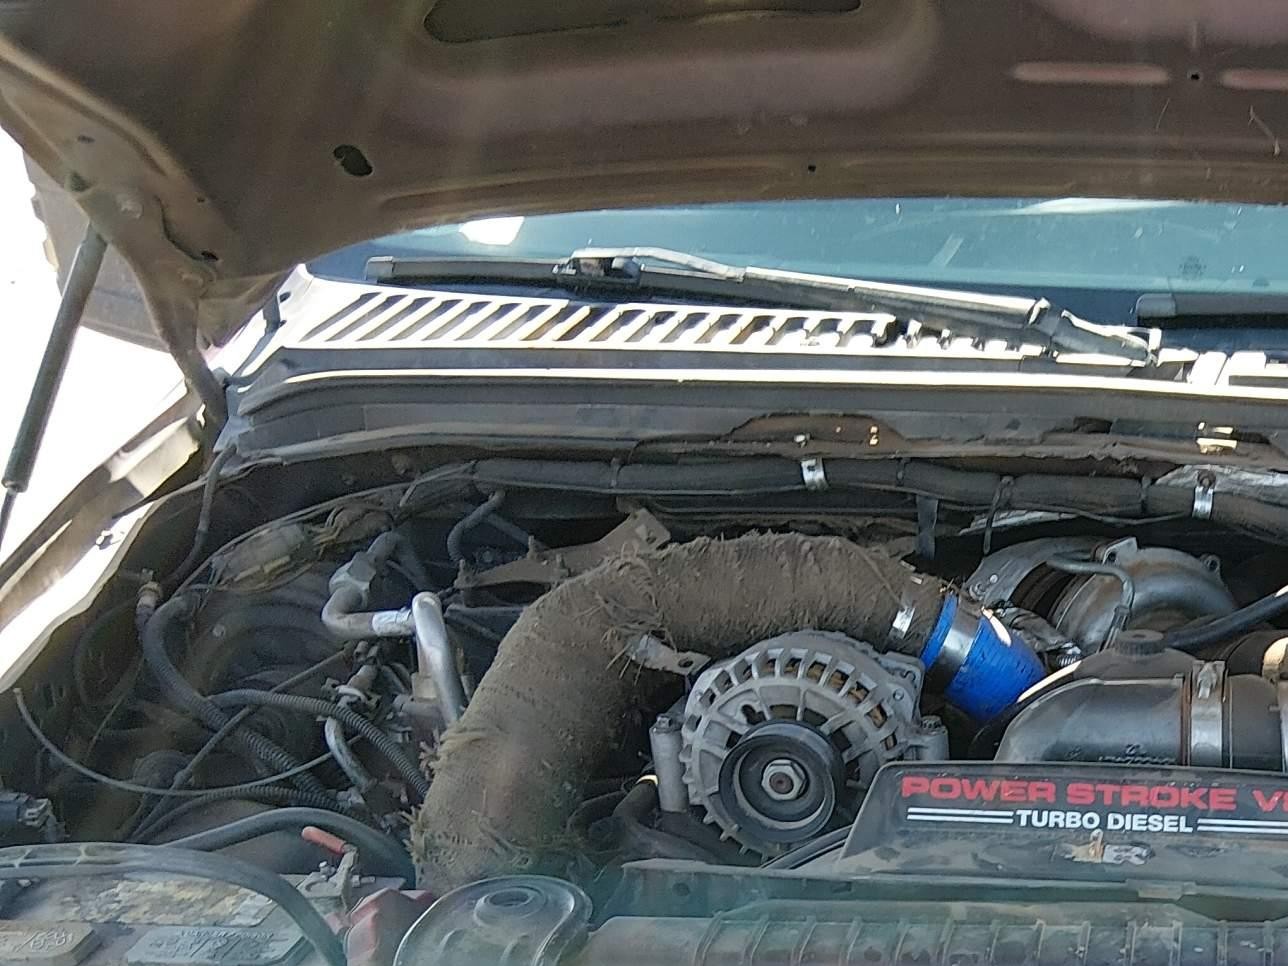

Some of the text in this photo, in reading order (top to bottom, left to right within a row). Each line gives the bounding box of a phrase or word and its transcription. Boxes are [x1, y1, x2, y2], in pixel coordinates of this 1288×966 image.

[902, 776, 1057, 802] POWER
[1067, 783, 1237, 811] STROKE
[1016, 810, 1193, 833] TURBO DIESEL
